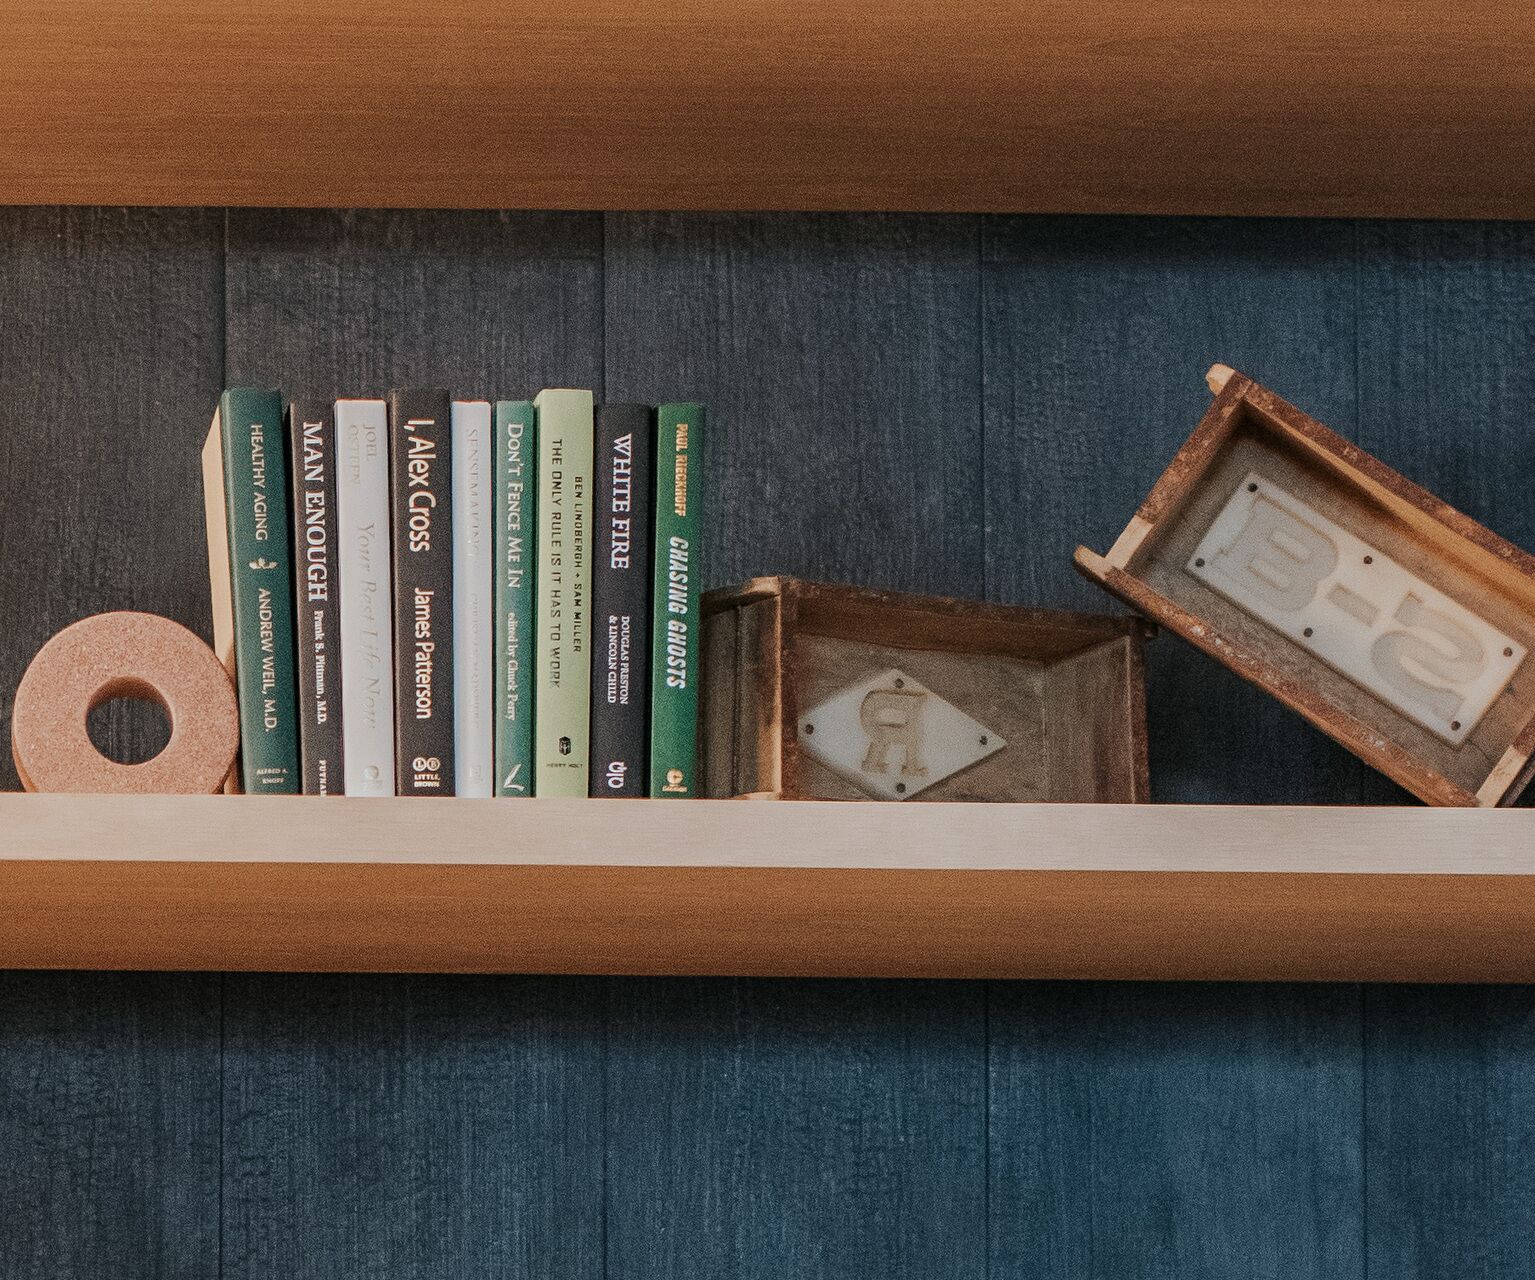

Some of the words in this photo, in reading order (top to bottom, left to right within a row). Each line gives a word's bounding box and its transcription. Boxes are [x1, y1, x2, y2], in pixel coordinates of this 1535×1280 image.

[363, 423, 377, 462] JOEL
[403, 418, 435, 431] I,
[675, 423, 689, 451] PAUL
[250, 423, 266, 489] HEALTHY
[302, 421, 325, 483] MAN
[408, 436, 437, 487] Alex
[507, 422, 524, 477] DON'T
[551, 438, 563, 466] THE
[551, 470, 563, 507] ONLY
[574, 476, 583, 499] BEN
[612, 432, 632, 513] WHITE
[674, 454, 688, 517] RIECKHOFF
[253, 492, 268, 541] AGING
[408, 490, 437, 553] Cross
[507, 480, 524, 531] FENCE
[305, 490, 328, 603] ENOUGH
[507, 537, 524, 563] ME
[551, 512, 562, 548] RULE
[574, 501, 583, 568] LINDBERGH
[611, 517, 630, 570] FIRE
[507, 568, 524, 589] IN
[551, 552, 562, 566] IS
[551, 570, 562, 584] IT
[667, 535, 689, 615] CHASING
[414, 587, 435, 640] James
[550, 590, 562, 619] HAS
[573, 583, 582, 607] SAM
[258, 587, 275, 653] ANDREW
[313, 609, 325, 641] Frank
[507, 612, 519, 640] edited
[550, 623, 561, 641] TO
[573, 611, 582, 653] MILLER
[620, 615, 630, 659] DOUGLAS
[506, 641, 519, 660] by
[549, 646, 561, 689] WORK
[608, 625, 618, 671] LINCOLN
[666, 620, 688, 690] GHOSTS
[261, 656, 276, 695] WEIL,
[315, 654, 328, 699] Pittman,
[414, 642, 435, 719] Patterson
[507, 660, 519, 694] Chuck
[608, 671, 617, 704] CHILD
[620, 660, 629, 706] PRESTON
[264, 699, 277, 732] M.D.
[317, 700, 328, 725] M.D.
[505, 694, 519, 721] Perry
